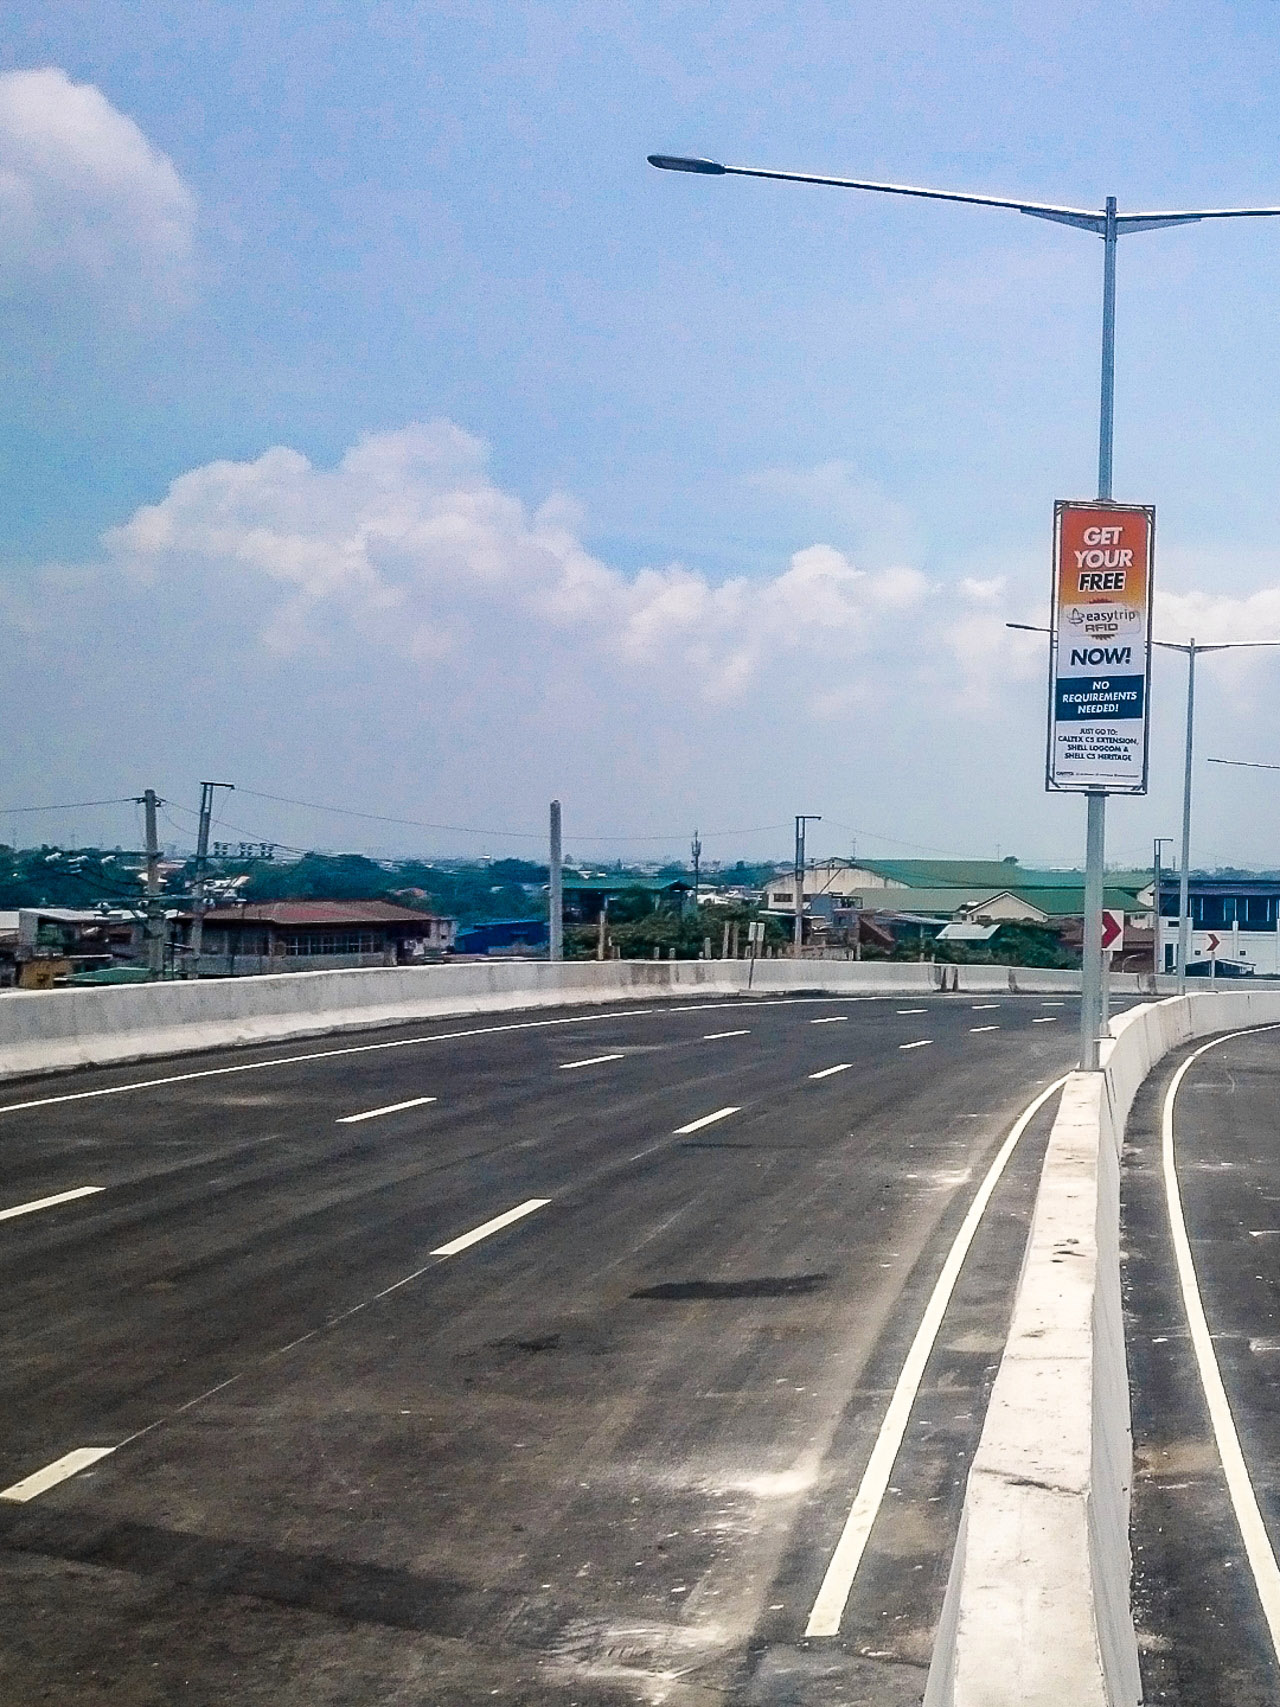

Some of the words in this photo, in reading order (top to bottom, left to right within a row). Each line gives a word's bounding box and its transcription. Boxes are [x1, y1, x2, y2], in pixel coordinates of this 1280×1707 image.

[1083, 527, 1123, 545] GET
[1074, 549, 1133, 568] YOUR
[1079, 572, 1125, 591] FREE
[1086, 609, 1136, 622] easytrip
[1085, 623, 1118, 632] RFID
[1070, 647, 1131, 666] NOW!
[1092, 681, 1110, 690] NO
[1062, 691, 1138, 703] REQUIREMENTS
[1077, 703, 1119, 714] NEEDED!
[1064, 752, 1085, 760] SHELL
[1097, 753, 1132, 761] HERITAGE
